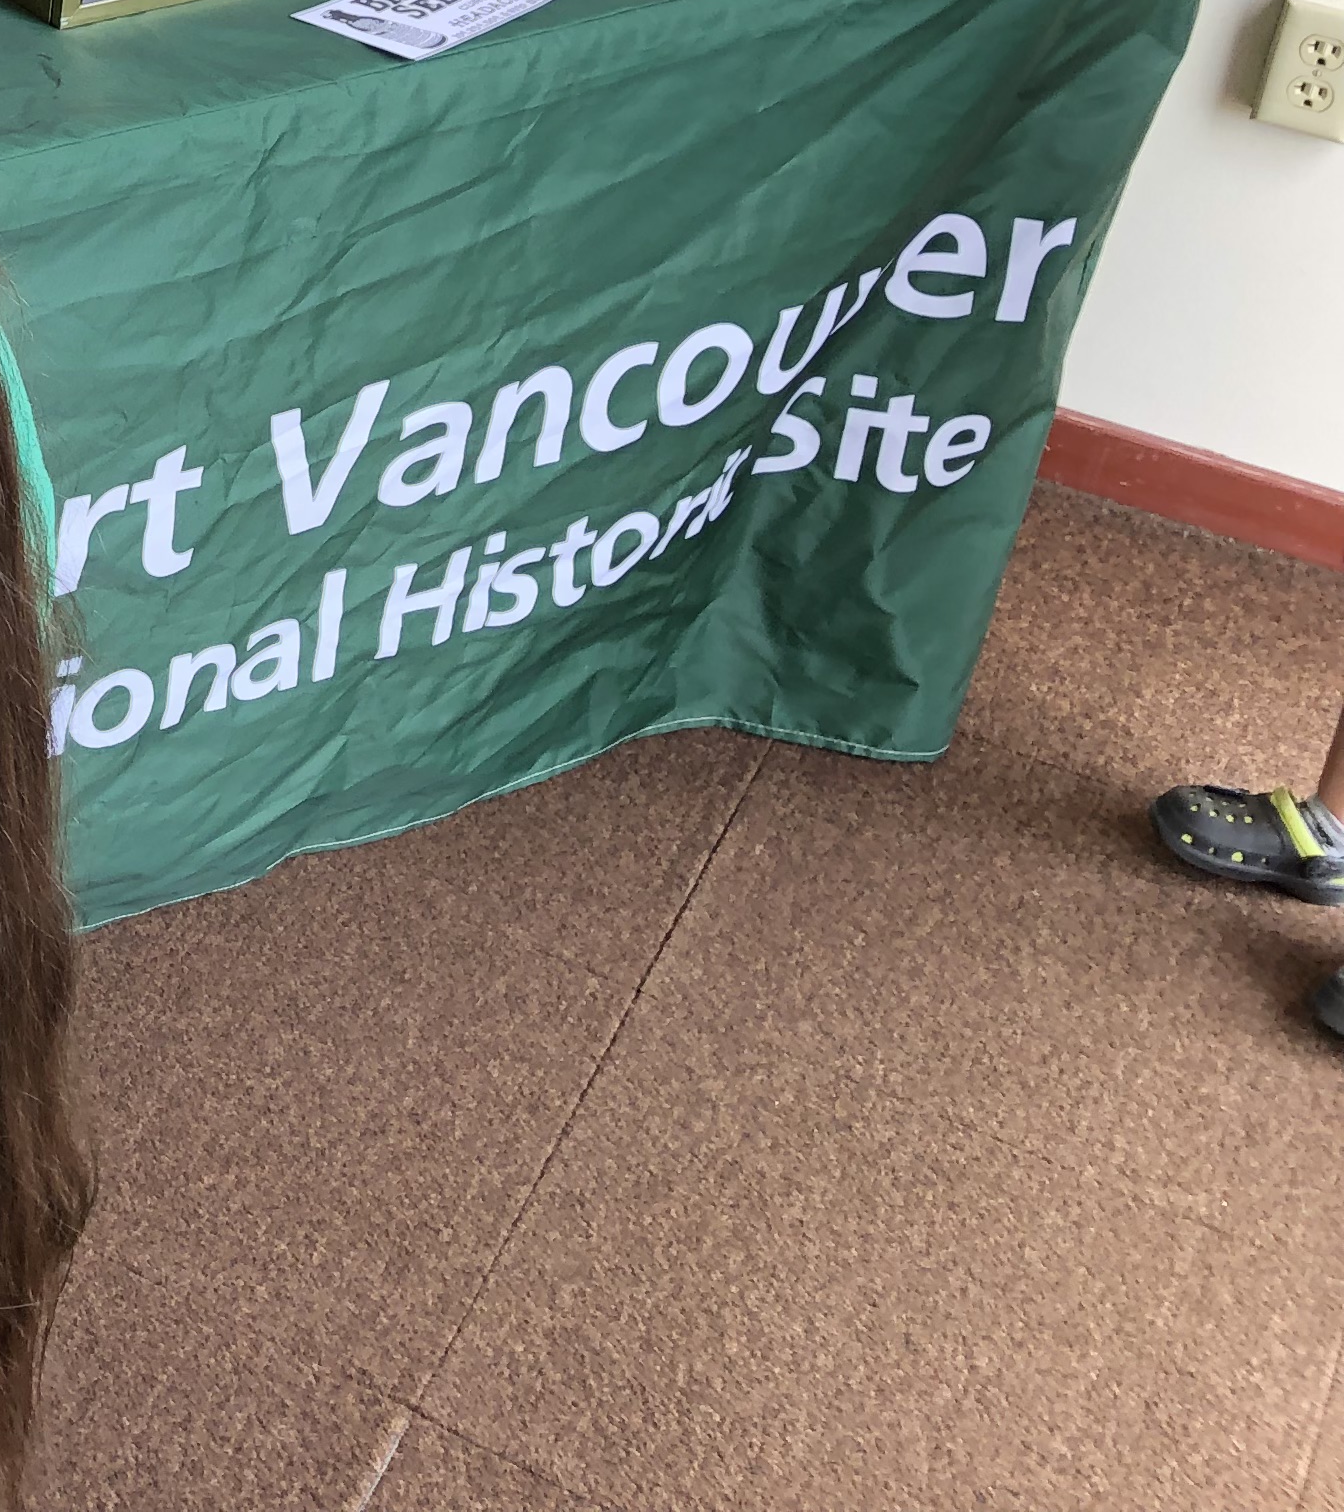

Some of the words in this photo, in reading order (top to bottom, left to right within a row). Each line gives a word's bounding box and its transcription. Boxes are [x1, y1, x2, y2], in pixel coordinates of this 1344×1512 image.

[47, 568, 348, 760] ional
[751, 375, 993, 494] Site
[55, 445, 204, 596] rt
[270, 213, 1078, 536] Vancouver
